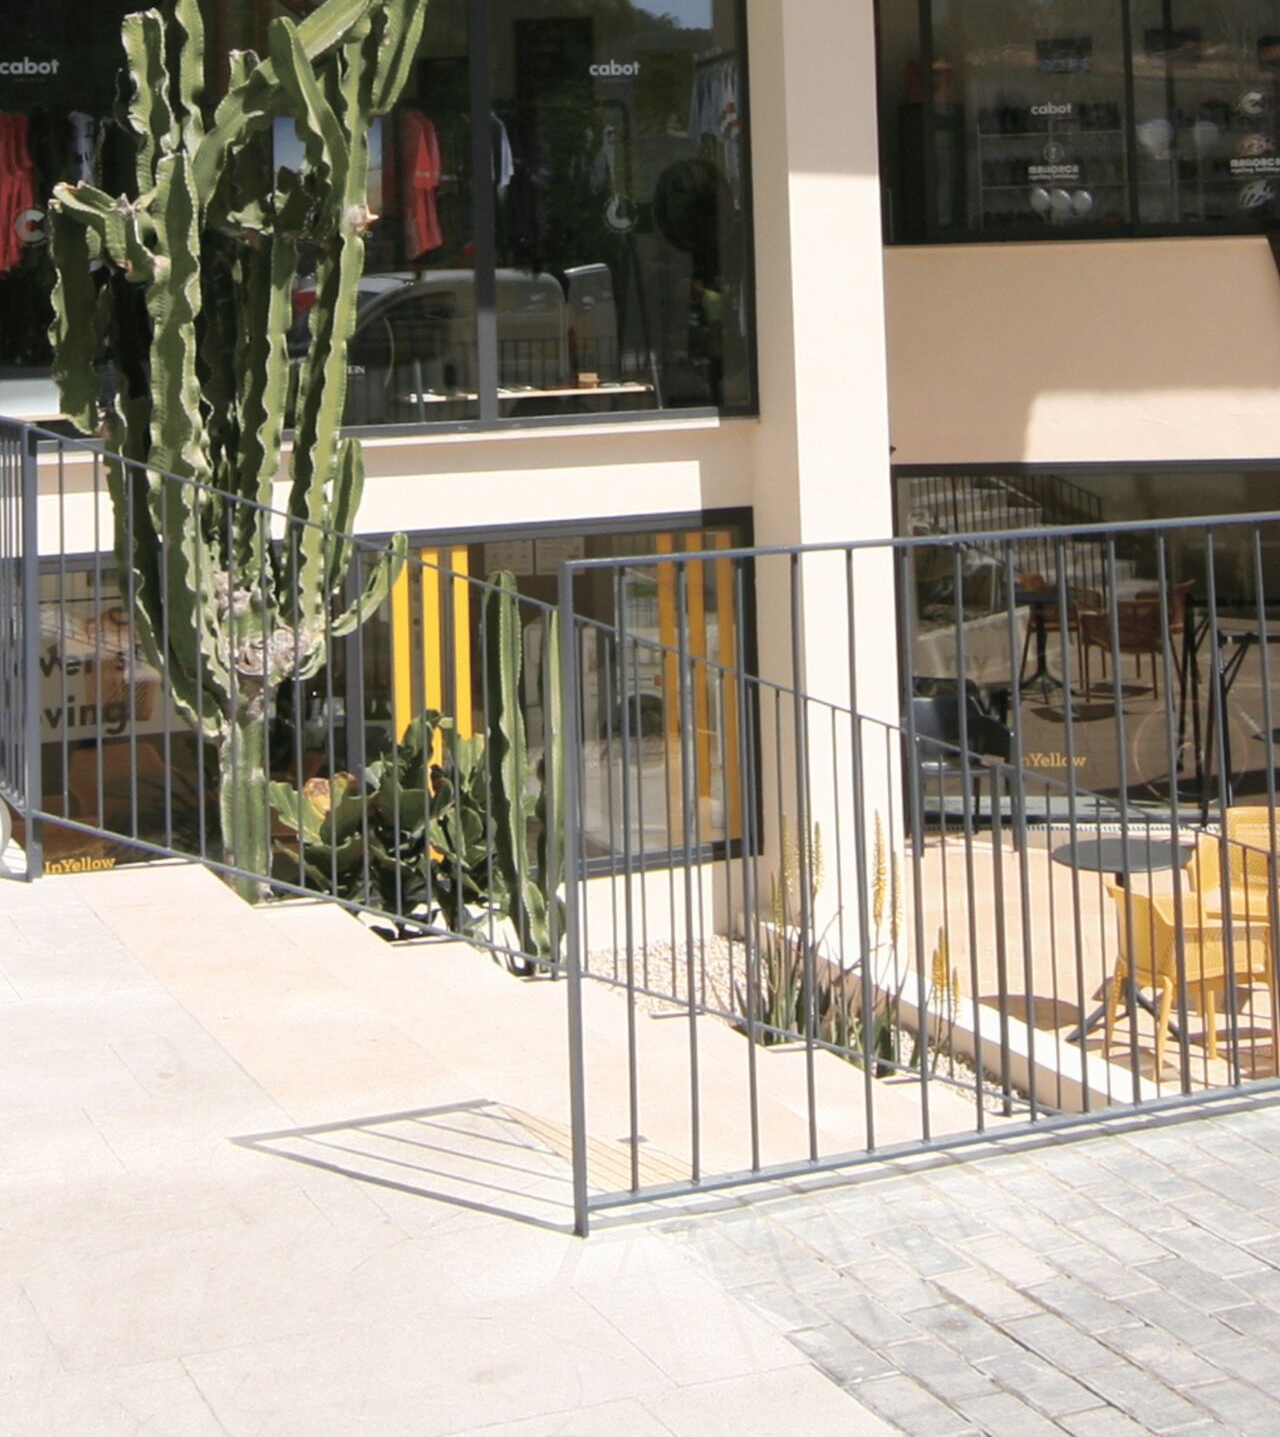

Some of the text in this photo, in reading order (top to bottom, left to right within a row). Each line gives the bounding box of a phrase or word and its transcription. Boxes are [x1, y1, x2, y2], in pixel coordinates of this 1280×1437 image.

[0, 56, 60, 75] cabot
[589, 59, 641, 76] cabot
[1030, 102, 1072, 115] cabot
